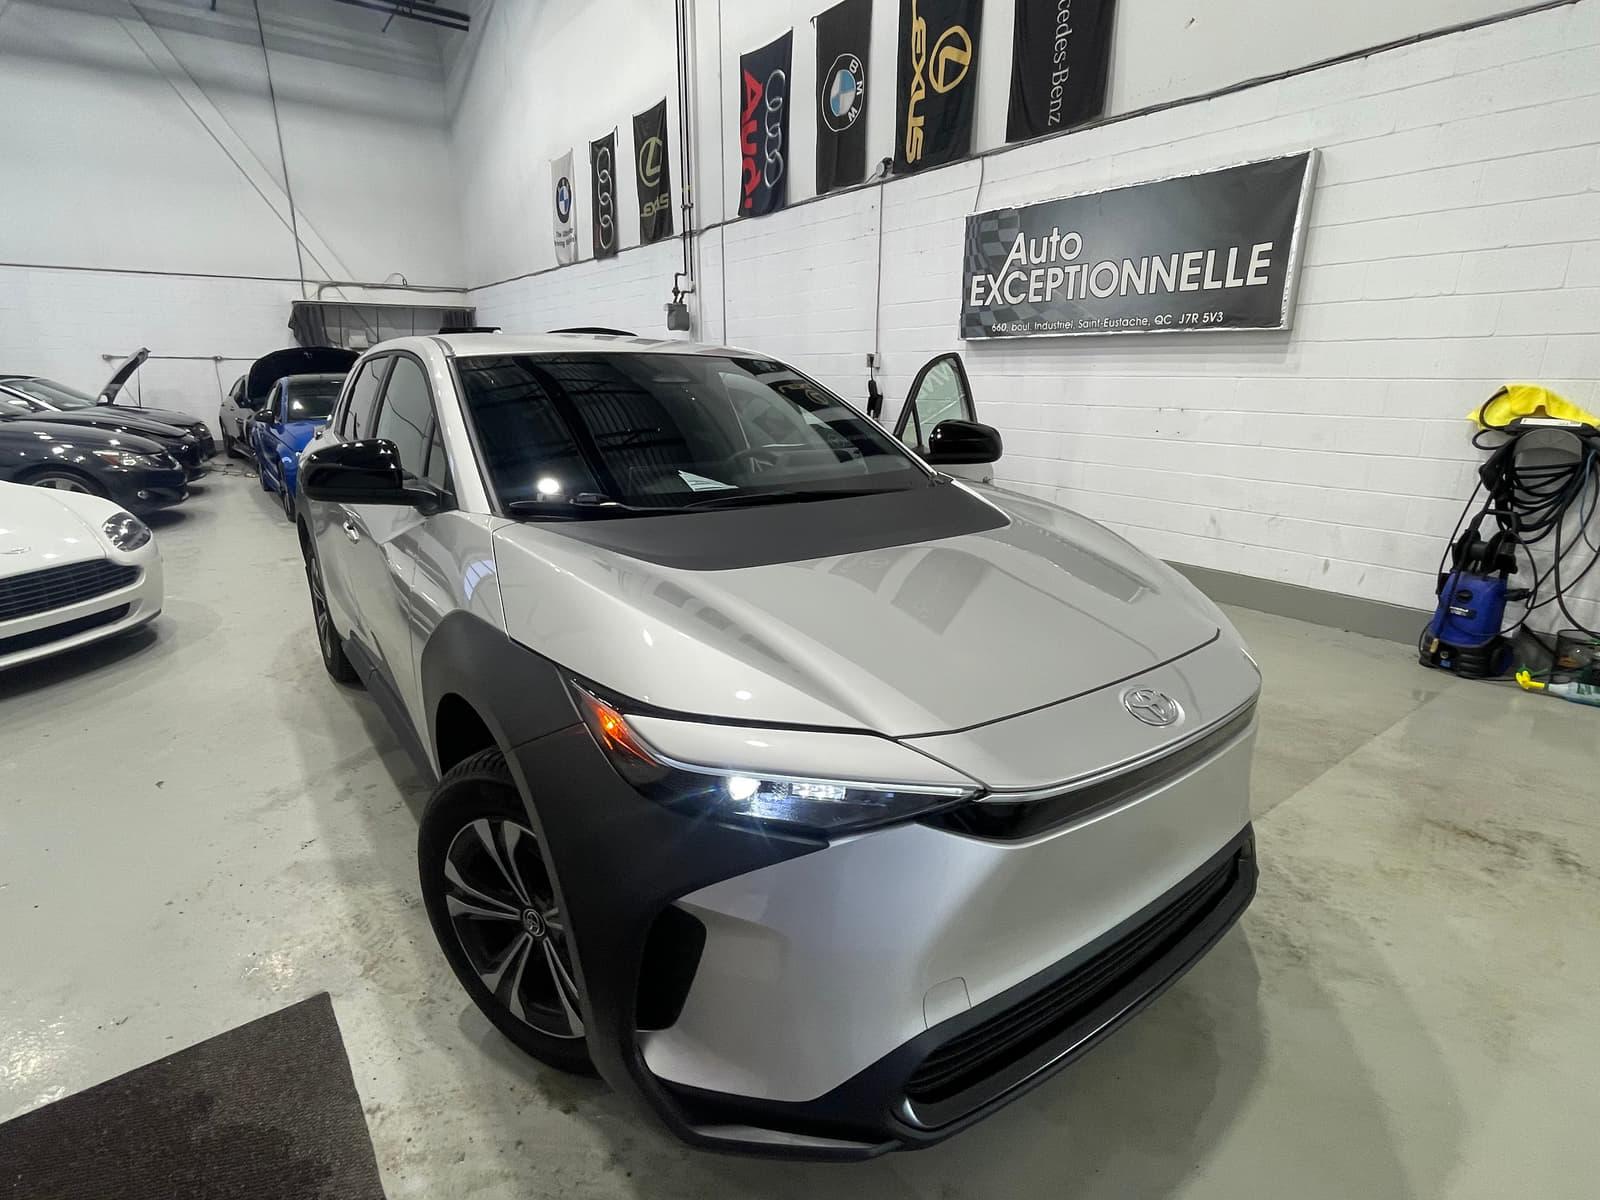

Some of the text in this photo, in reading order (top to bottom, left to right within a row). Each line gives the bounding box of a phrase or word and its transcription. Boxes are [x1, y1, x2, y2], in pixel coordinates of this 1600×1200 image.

[1003, 226, 1083, 267] Auto
[969, 241, 1274, 307] EXCEPTIONNELLE
[1154, 314, 1173, 326] QC
[1178, 312, 1199, 324] J7R
[1202, 311, 1224, 323] 5V3
